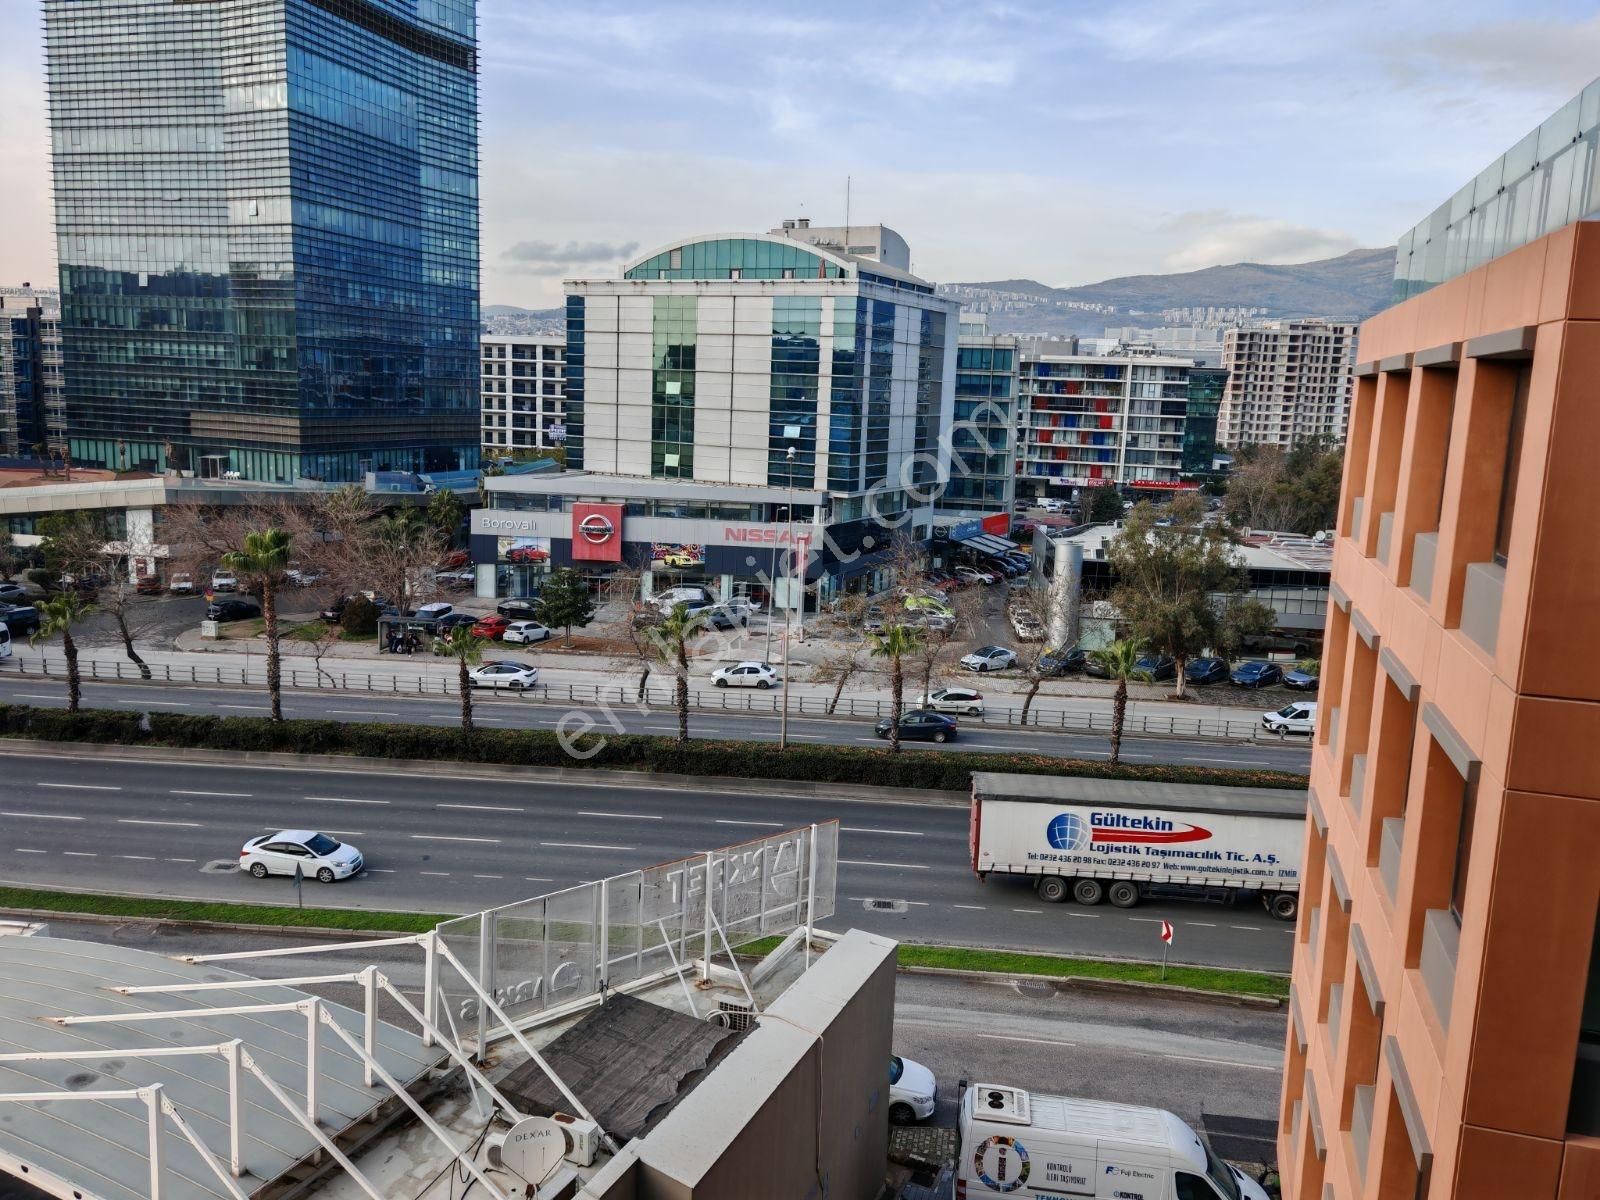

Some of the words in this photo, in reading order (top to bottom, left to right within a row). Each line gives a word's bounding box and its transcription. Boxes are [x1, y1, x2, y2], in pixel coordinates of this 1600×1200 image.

[1090, 811, 1174, 832] Gültekin
[1027, 852, 1039, 861] Tel:
[1039, 853, 1058, 862] 0232
[1058, 855, 1072, 863] 436
[1072, 856, 1082, 864] 20
[1083, 857, 1092, 865] 98
[1093, 857, 1106, 865] Fax:
[1107, 859, 1126, 867] 0232
[1126, 859, 1141, 868] 436
[1141, 860, 1151, 868] 20
[1151, 861, 1161, 869] 97
[1163, 862, 1180, 871] Web:
[1089, 842, 1141, 855] Lojistik
[1144, 846, 1223, 861] Taşımacılık
[1226, 851, 1250, 863] Tic.
[1252, 853, 1281, 866] A.Ş.
[515, 1130, 552, 1143] DEXAR
[1120, 1169, 1132, 1177] Fuji
[1132, 1170, 1155, 1179] Electric
